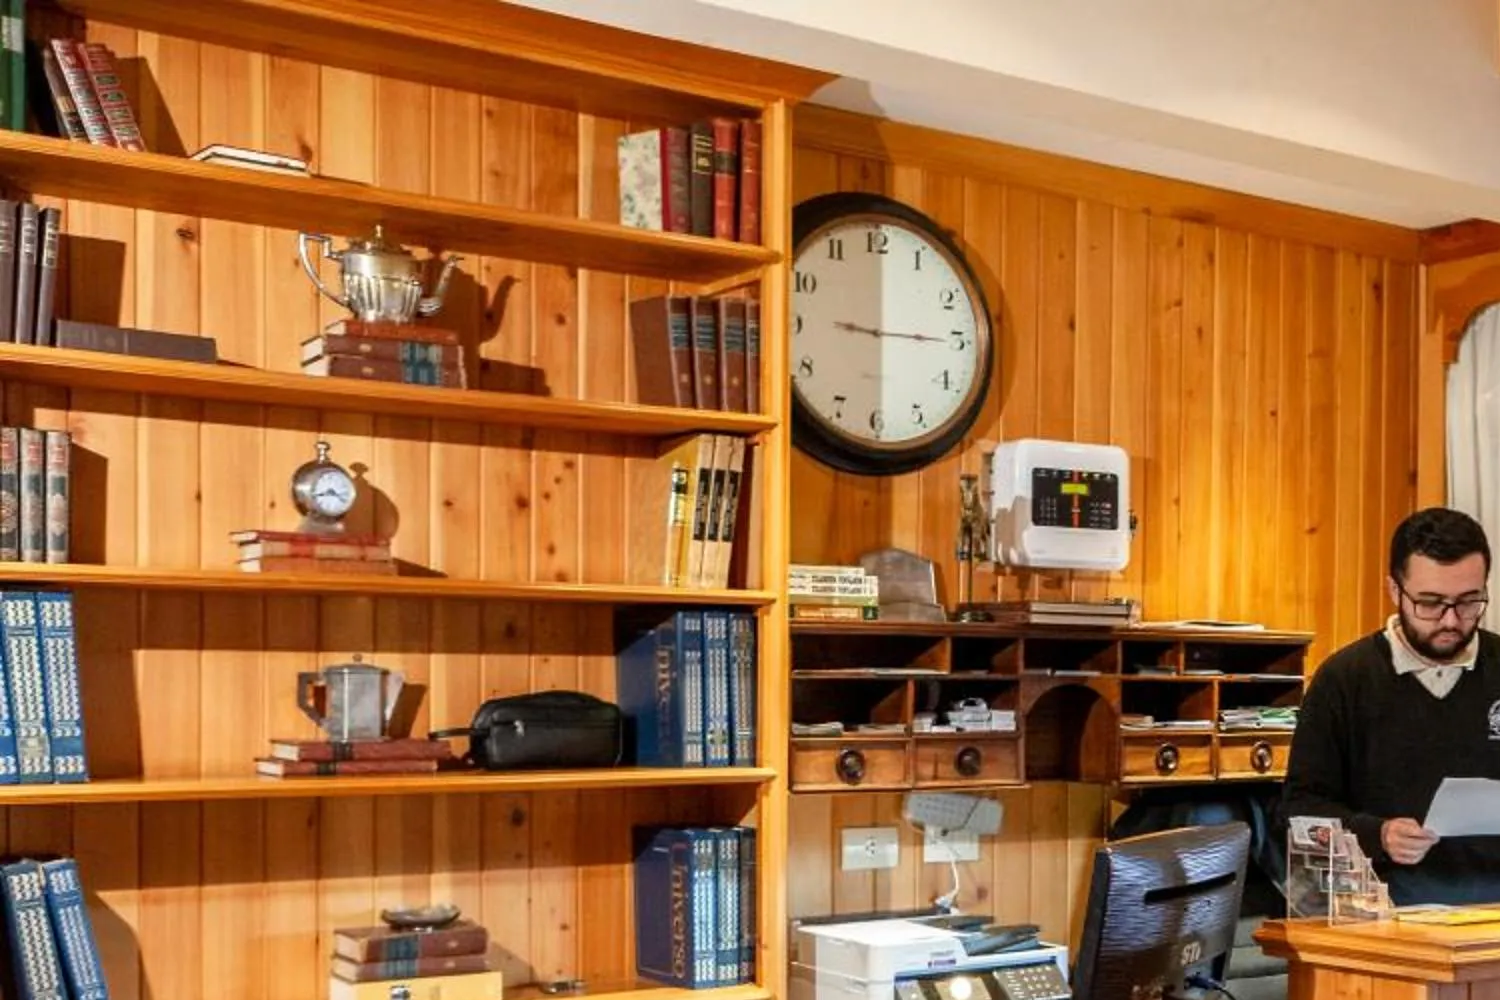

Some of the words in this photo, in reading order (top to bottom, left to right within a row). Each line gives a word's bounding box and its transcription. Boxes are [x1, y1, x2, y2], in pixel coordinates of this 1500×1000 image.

[828, 239, 844, 261] 11
[867, 231, 889, 254] 12
[913, 250, 921, 271] 1
[795, 271, 817, 294] 10
[939, 289, 955, 310] 2
[950, 330, 966, 351] 3
[799, 356, 815, 377] 8
[932, 370, 953, 391] 4
[833, 395, 847, 418] 7
[912, 404, 923, 425] 5
[870, 410, 884, 432] 6
[671, 842, 689, 980] Universo
